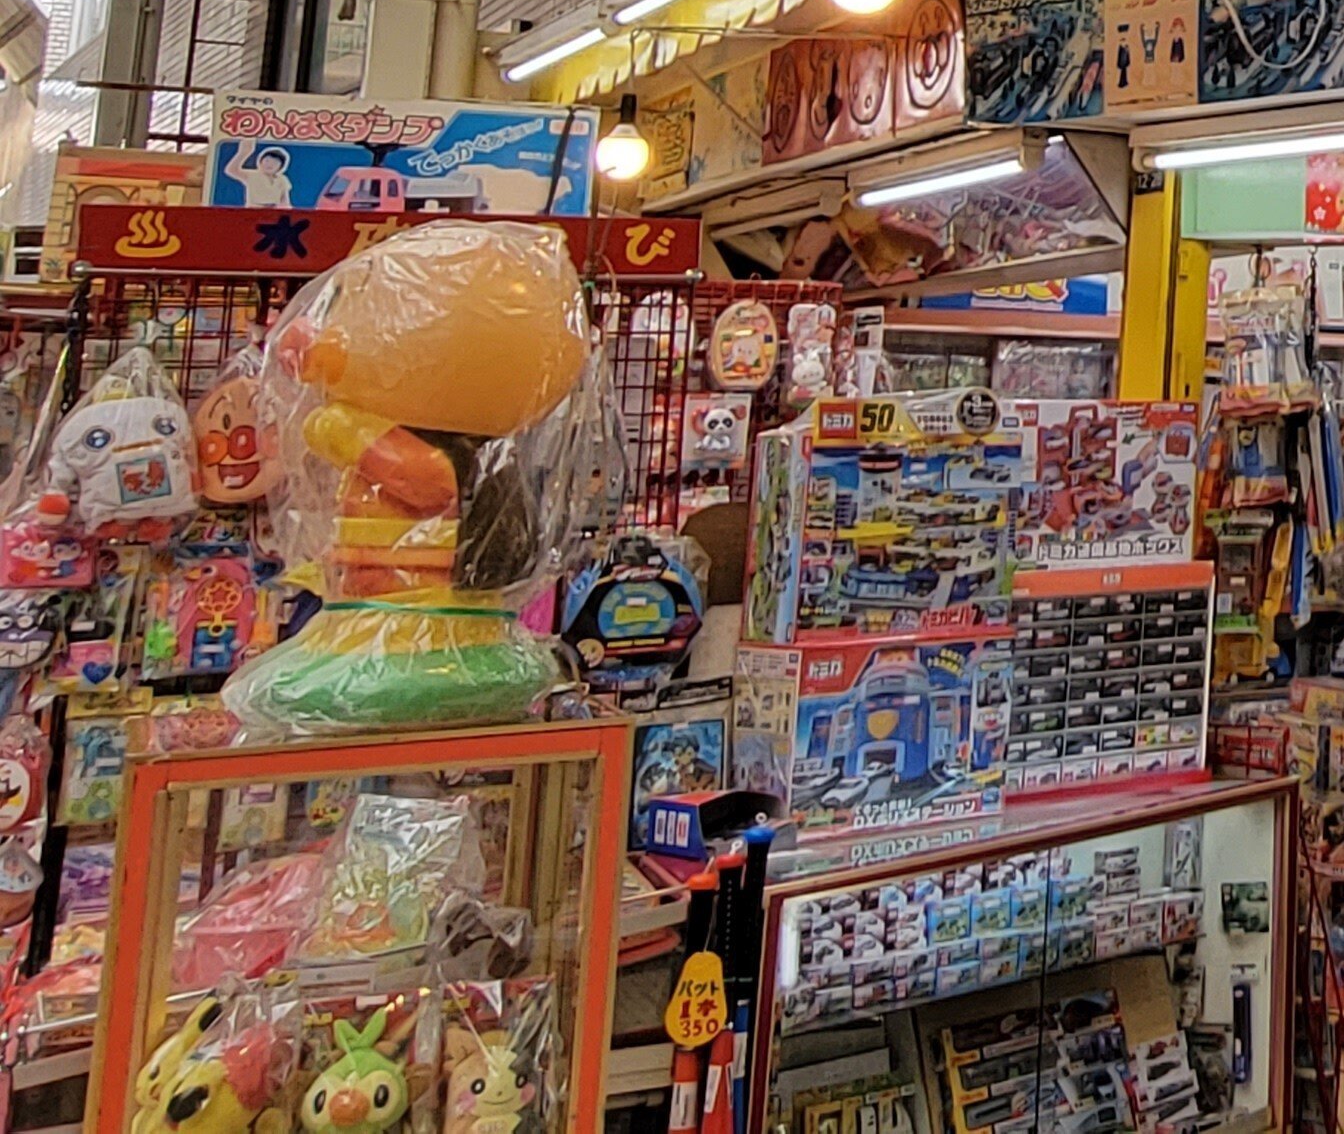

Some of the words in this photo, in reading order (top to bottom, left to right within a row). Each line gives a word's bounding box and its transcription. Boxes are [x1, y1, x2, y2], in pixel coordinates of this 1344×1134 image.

[220, 106, 445, 145] わんぱくダンプ
[860, 403, 896, 433] 50
[808, 658, 843, 680] トミカ
[680, 1018, 719, 1039] 350
